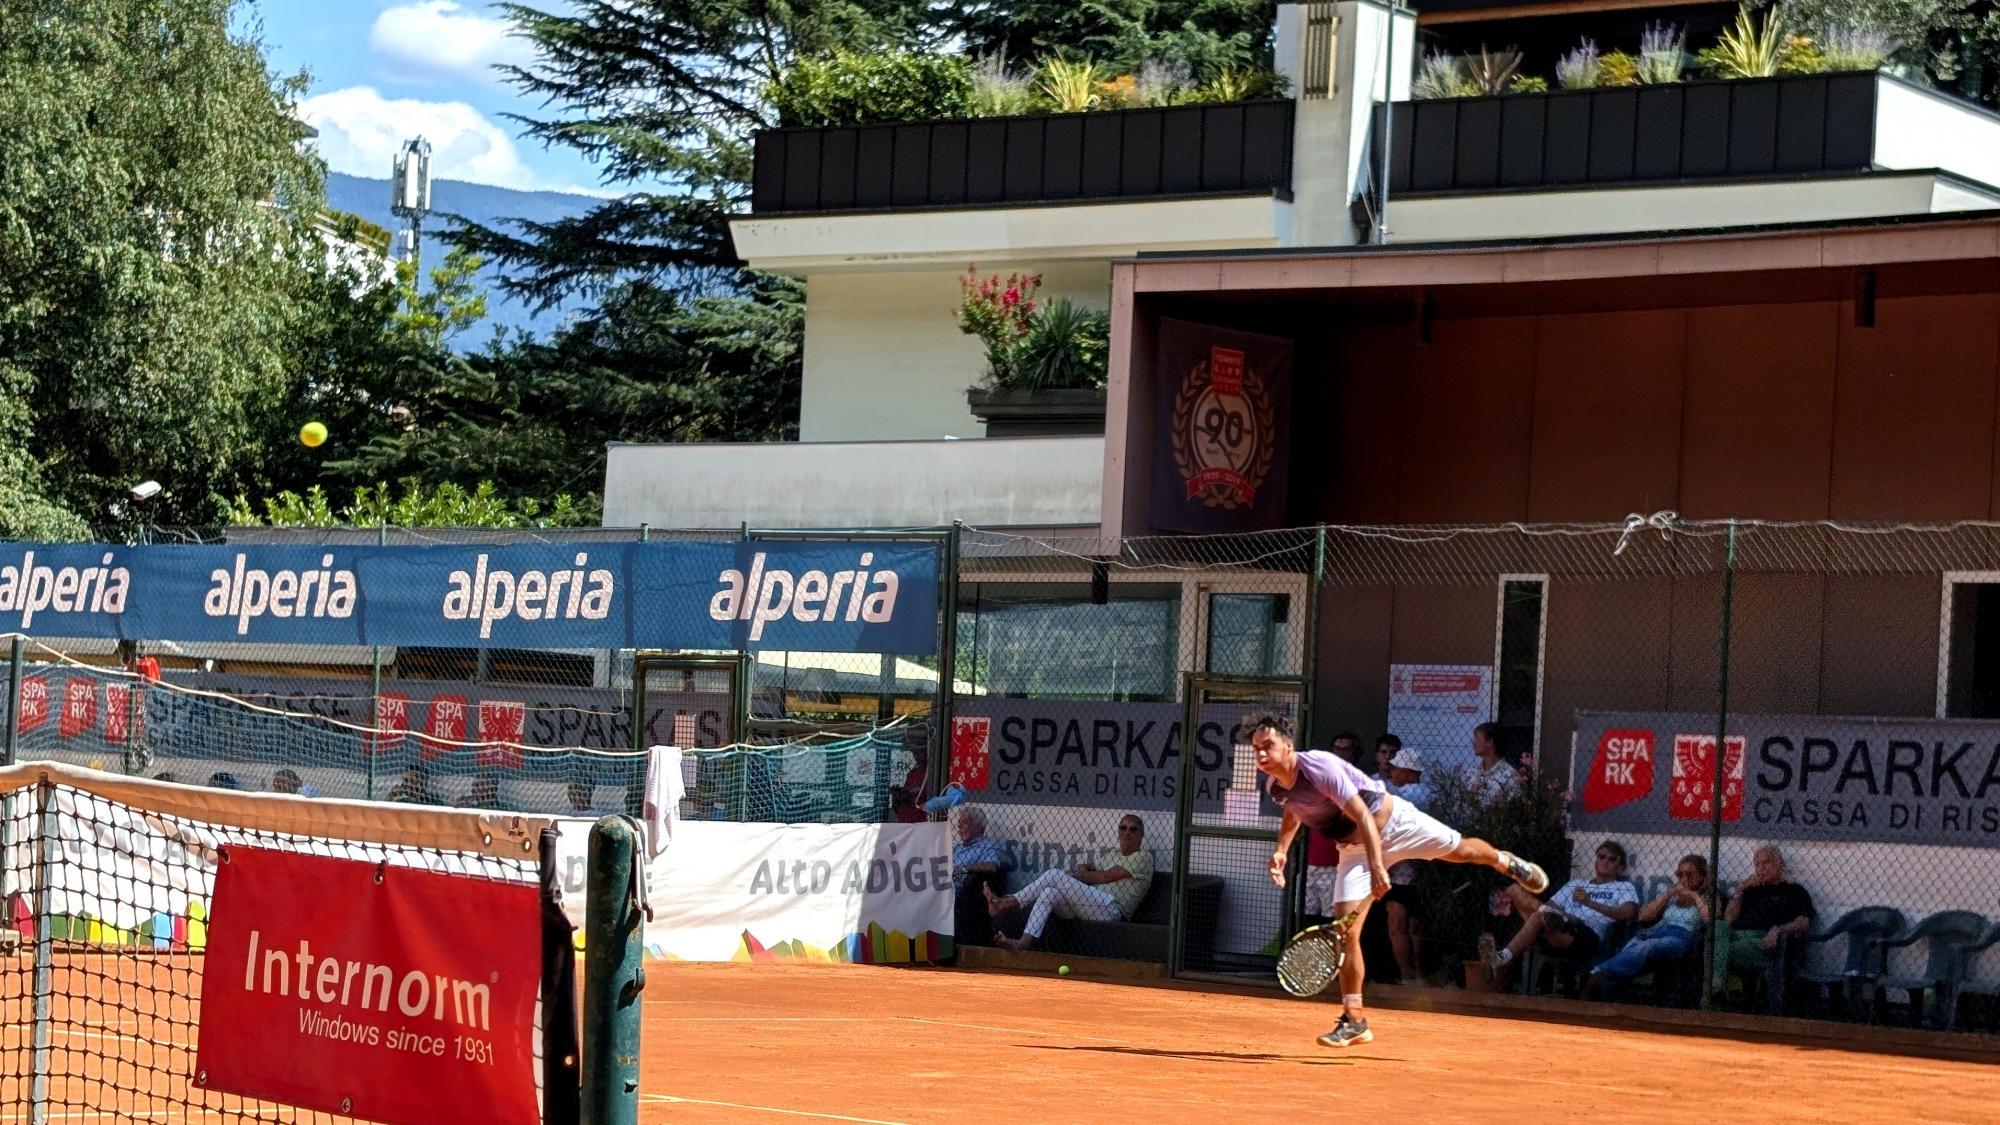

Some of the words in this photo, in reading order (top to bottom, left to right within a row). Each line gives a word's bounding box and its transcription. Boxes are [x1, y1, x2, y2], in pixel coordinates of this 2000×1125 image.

[1205, 408, 1244, 448] 90
[0, 551, 130, 629] alperia
[205, 553, 357, 635] alperia
[443, 552, 614, 639] alperia
[710, 552, 898, 641] alperia
[22, 682, 46, 699] SPA
[70, 684, 94, 702] SPA
[21, 700, 38, 716] RK
[71, 702, 87, 719] RK
[377, 699, 405, 717] SPA
[435, 701, 463, 720] SPA
[434, 721, 455, 738] RK
[1607, 738, 1648, 761] SPA
[997, 770, 1080, 793] CASSA
[1095, 773, 1119, 795] DI
[1605, 762, 1635, 785] RK
[1753, 797, 1868, 827] CASSA
[1889, 803, 1922, 830] DI
[1942, 805, 2000, 834] RIS
[299, 1007, 380, 1046] Windows
[386, 1025, 445, 1056] since
[454, 1035, 494, 1066] 1931
